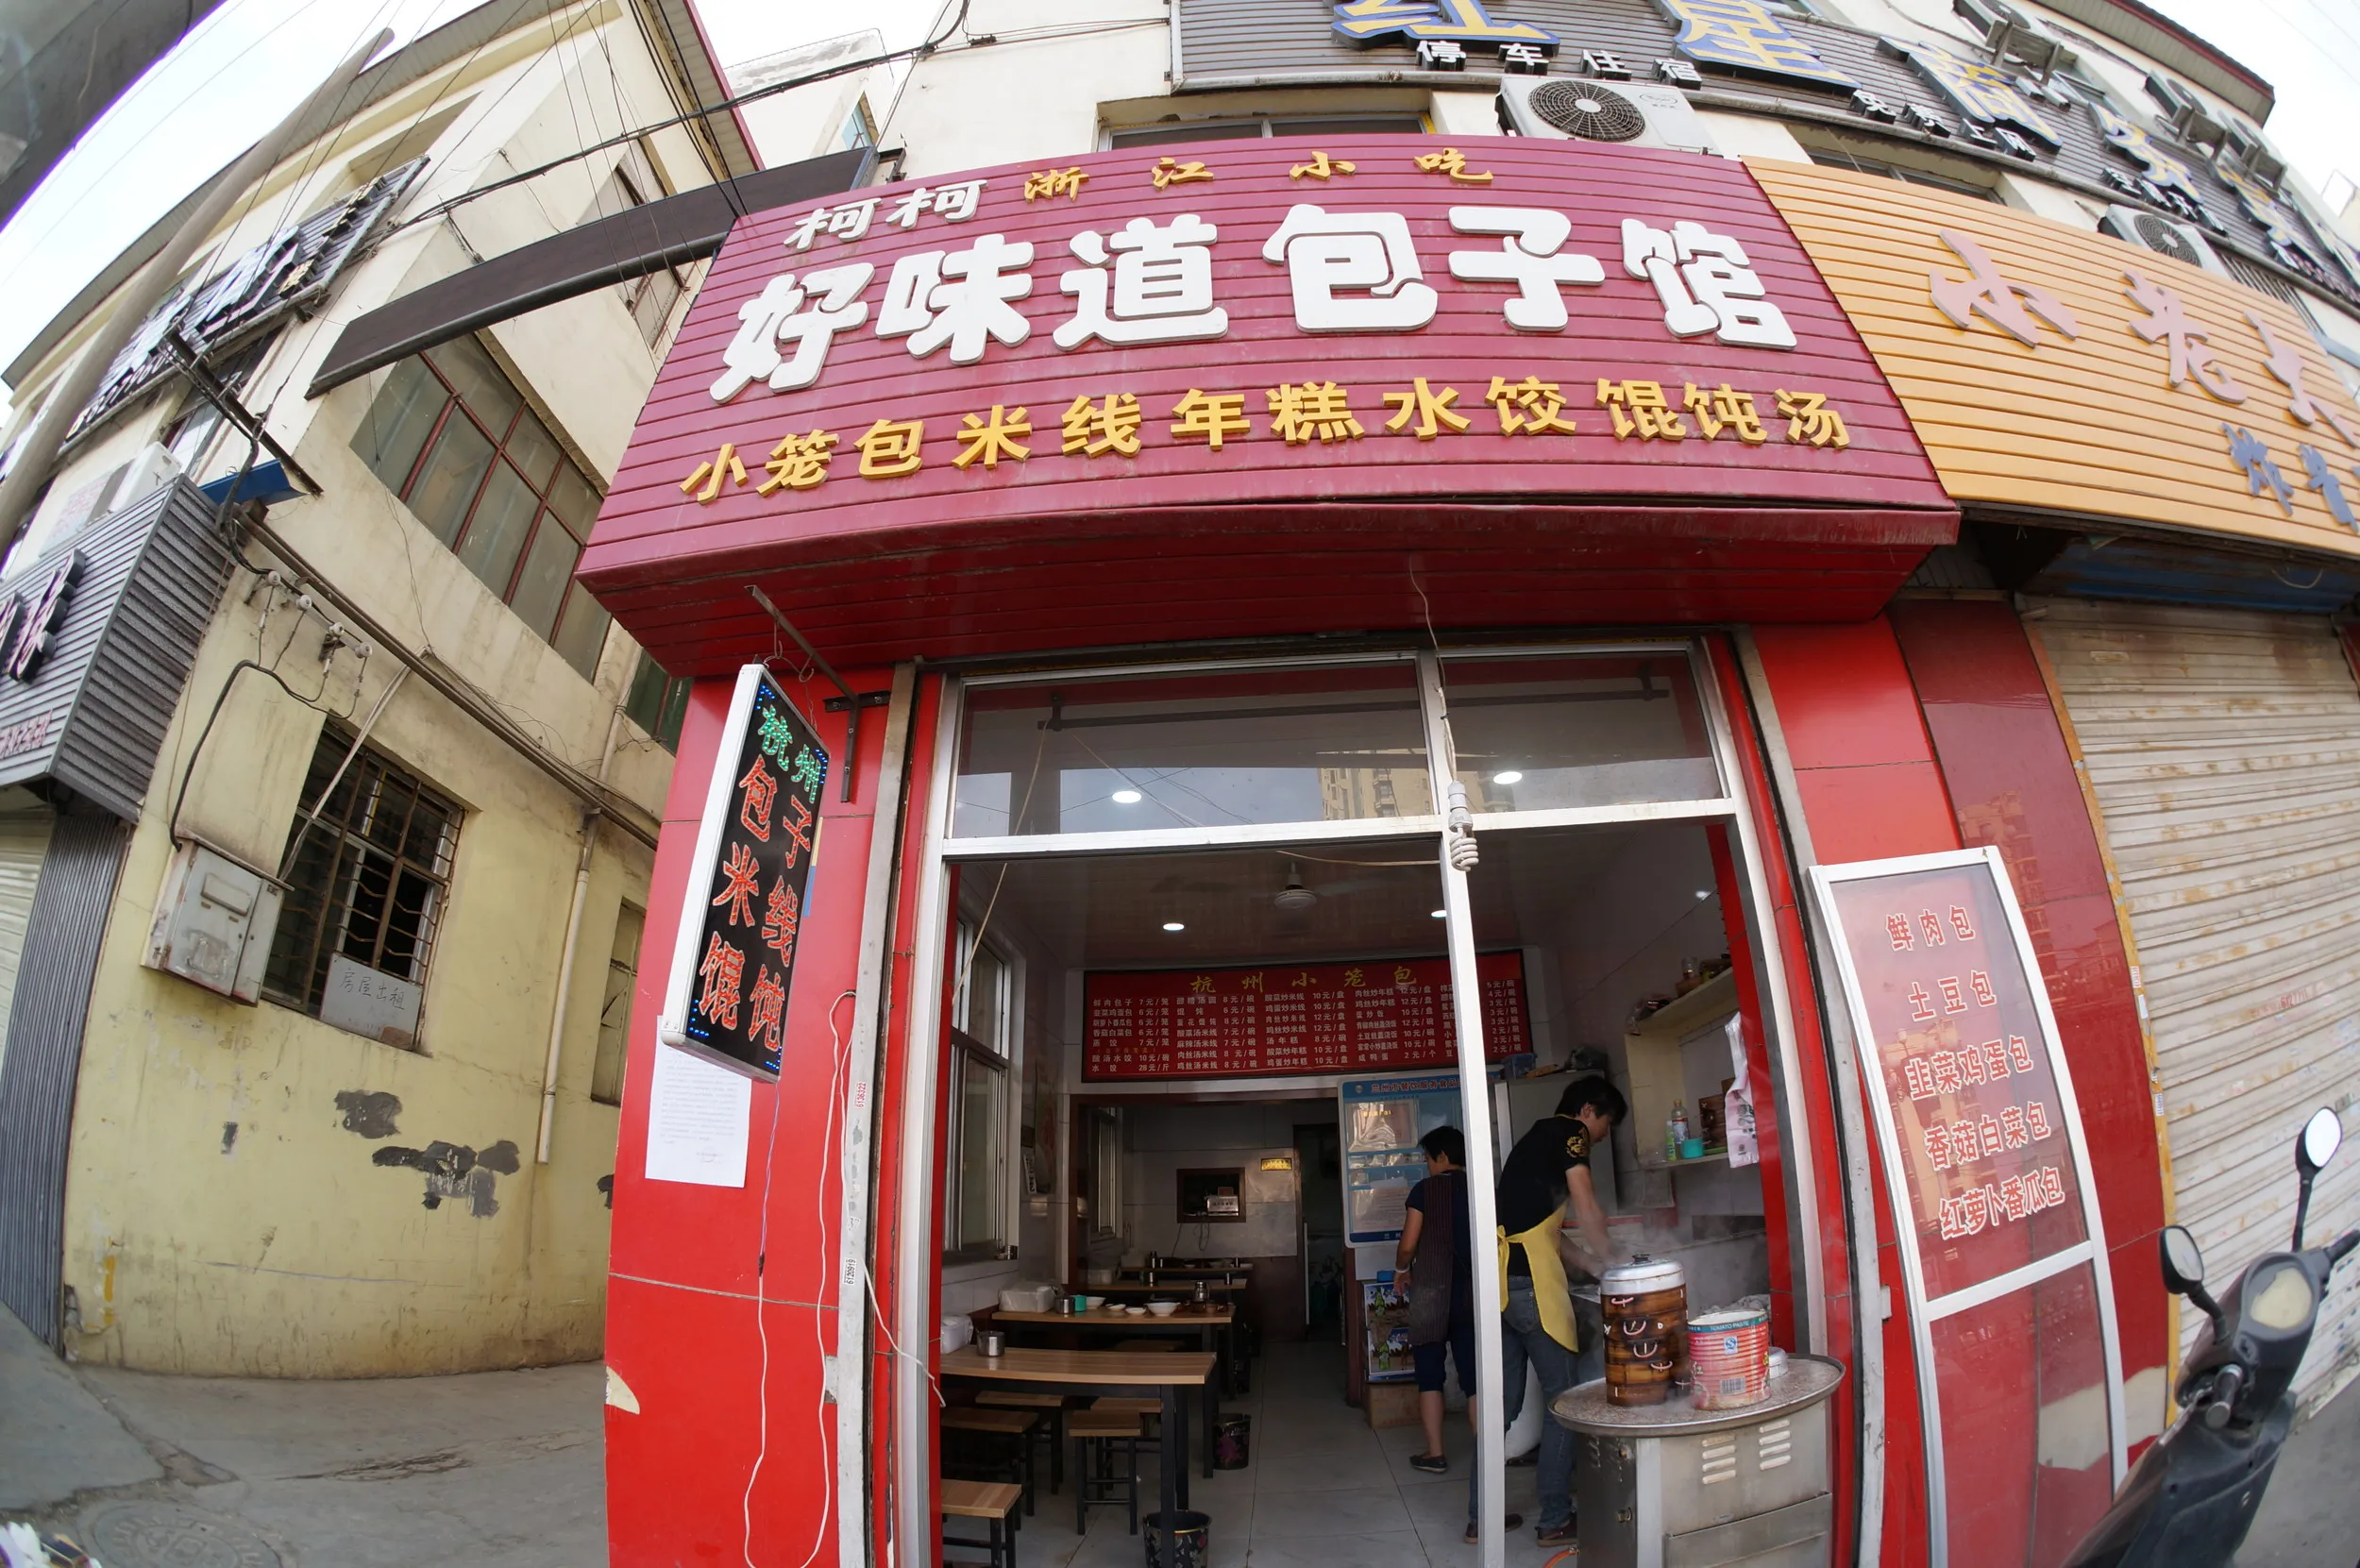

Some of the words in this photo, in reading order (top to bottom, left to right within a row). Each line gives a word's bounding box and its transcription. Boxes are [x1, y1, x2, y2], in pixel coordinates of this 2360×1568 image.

[1417, 40, 1702, 89] 停车住宿
[1851, 89, 2036, 160] 免费上网
[1023, 148, 1492, 203] 浙江小吃
[784, 178, 989, 251] 柯柯
[709, 203, 1798, 404] 好味道包子馆
[679, 376, 1851, 505] 小笼包米线年糕水饺馄饨汤
[757, 703, 821, 803] 杭州
[738, 754, 813, 870] 包子
[713, 840, 800, 968] 米线
[1885, 905, 1977, 952] 鲜肉包
[340, 966, 405, 1010] 房屋出租
[700, 930, 786, 1052] 馄饨
[1093, 998, 1133, 1007] 鲜肉包子
[1188, 965, 1417, 994] 杭州小笼包
[1908, 970, 1998, 1021] 土豆包
[1093, 1008, 1133, 1017] 韭菜鸡蛋包
[1093, 1028, 1133, 1037] 香菇白菜包
[1177, 1051, 1218, 1059] 肉丝汤米线
[1267, 1036, 1299, 1045] 汤年糕
[1405, 1050, 1436, 1059] 2元/个
[1092, 1064, 1117, 1072] 水饺
[1372, 1078, 1461, 1093] 兰州市餐饮服务食品
[1905, 1035, 2034, 1102] 韭菜鸡蛋包
[855, 1082, 866, 1107] 6136322
[1924, 1101, 2051, 1172] 香菇白菜包
[1938, 1167, 2065, 1242] 红萝卜番瓜包
[845, 1257, 856, 1285] 6120919
[1711, 1323, 1732, 1331] TOMATO
